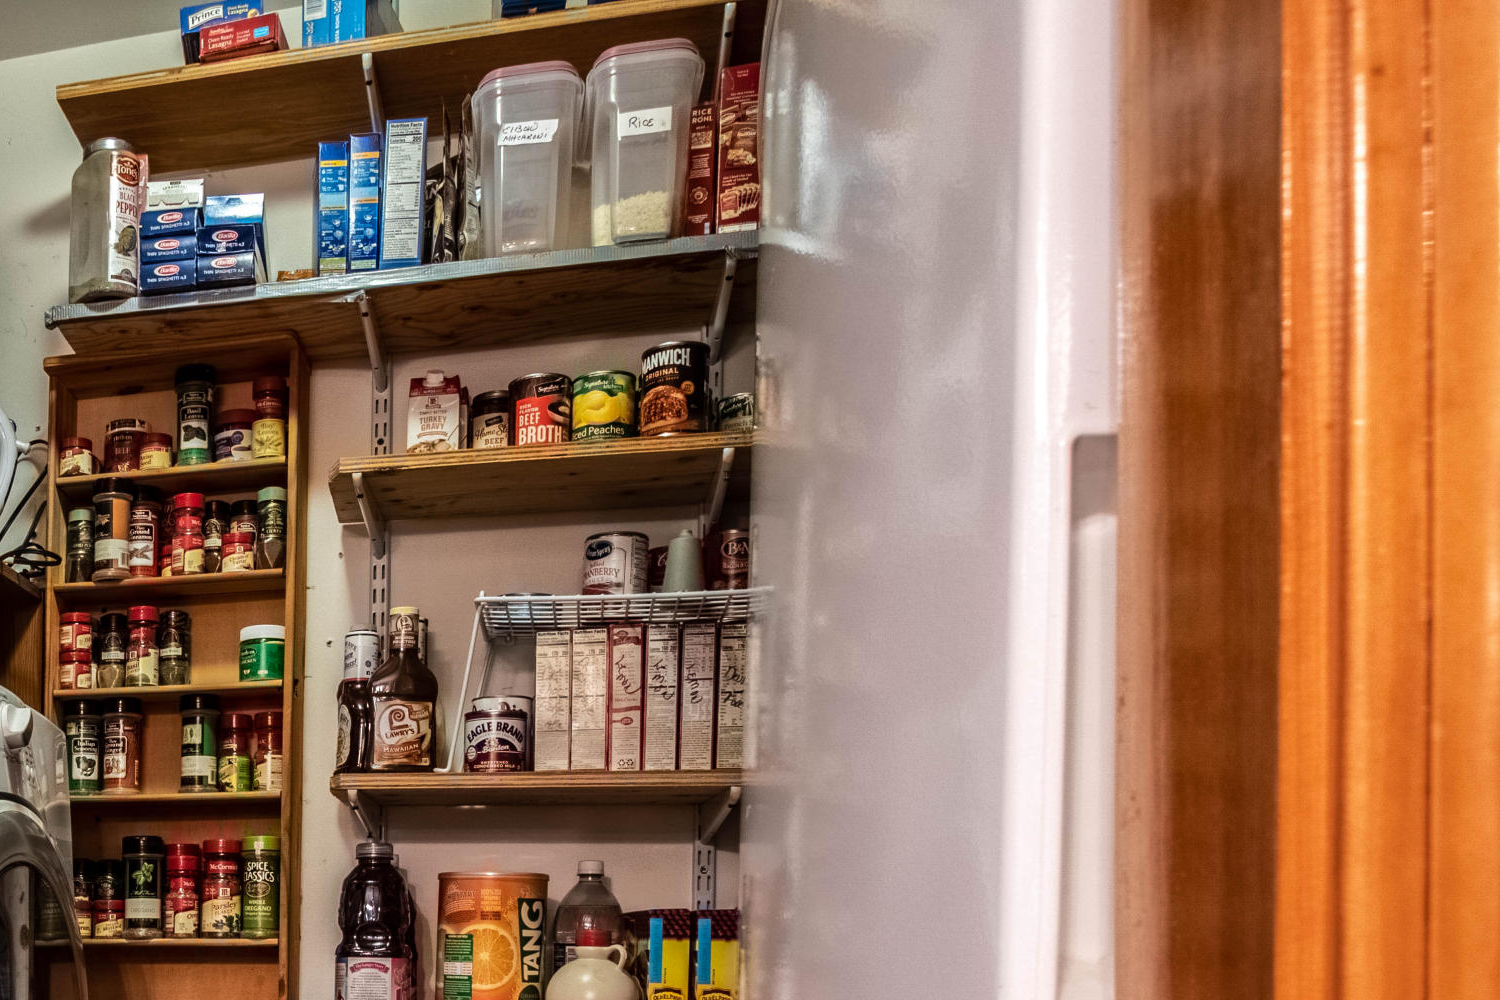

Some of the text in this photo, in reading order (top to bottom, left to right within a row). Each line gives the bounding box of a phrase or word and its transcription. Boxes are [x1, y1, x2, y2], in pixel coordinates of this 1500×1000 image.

[191, 8, 220, 25] Prince
[208, 40, 232, 50] Lasagna
[692, 107, 712, 116] RICE
[116, 201, 138, 217] PEPPE
[164, 212, 182, 221] Barilla
[218, 231, 237, 240] Barilla
[160, 240, 179, 249] Barilla
[217, 258, 236, 267] Barilla
[160, 265, 179, 274] Barilla
[645, 367, 679, 382] ORIGINAL
[420, 416, 447, 425] TURKEY
[519, 412, 541, 427] BEEF
[421, 423, 445, 431] GRAVY
[475, 424, 496, 439] Home
[588, 425, 625, 436] Peaches
[519, 425, 563, 446] BROTH
[485, 437, 504, 446] BEEF
[385, 729, 415, 739] LAWRY'S
[467, 722, 524, 743] EAGLE BRAND
[383, 743, 419, 752] HAWAIIAN
[247, 861, 268, 872] SPICE
[212, 901, 237, 911] Parsley
[521, 900, 543, 981] TANG
